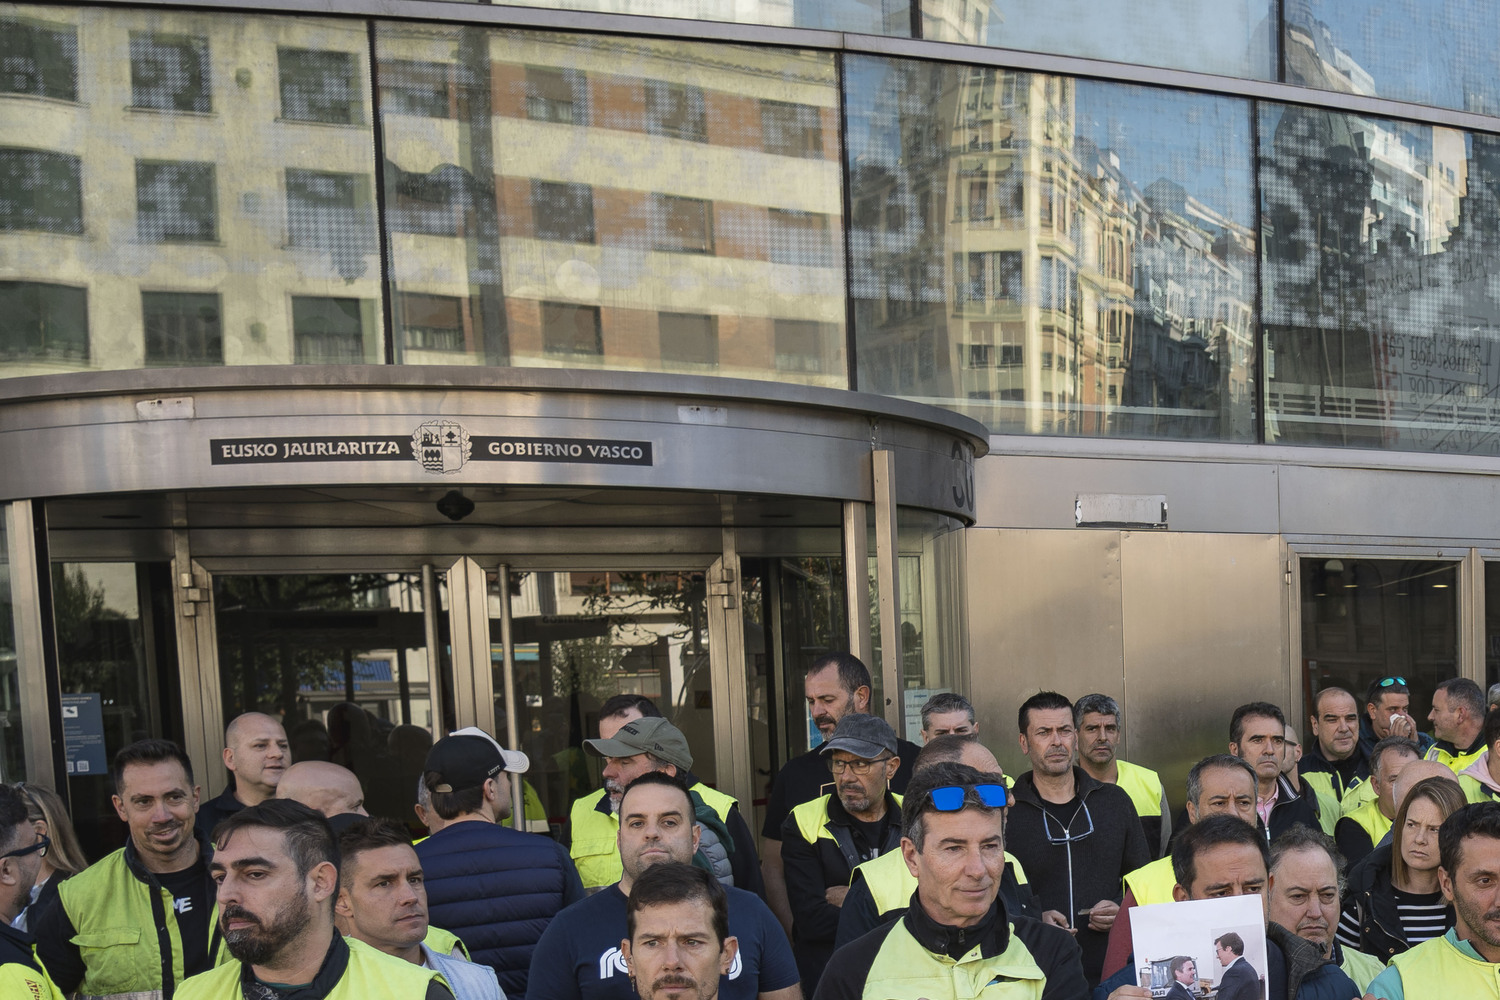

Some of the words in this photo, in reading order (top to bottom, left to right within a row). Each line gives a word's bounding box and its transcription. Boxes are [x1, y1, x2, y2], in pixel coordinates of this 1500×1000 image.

[222, 443, 278, 458] EUSKO
[283, 441, 400, 458] JAURLARITZA
[488, 442, 582, 457] GOBIERNO
[587, 445, 643, 459] VASCO
